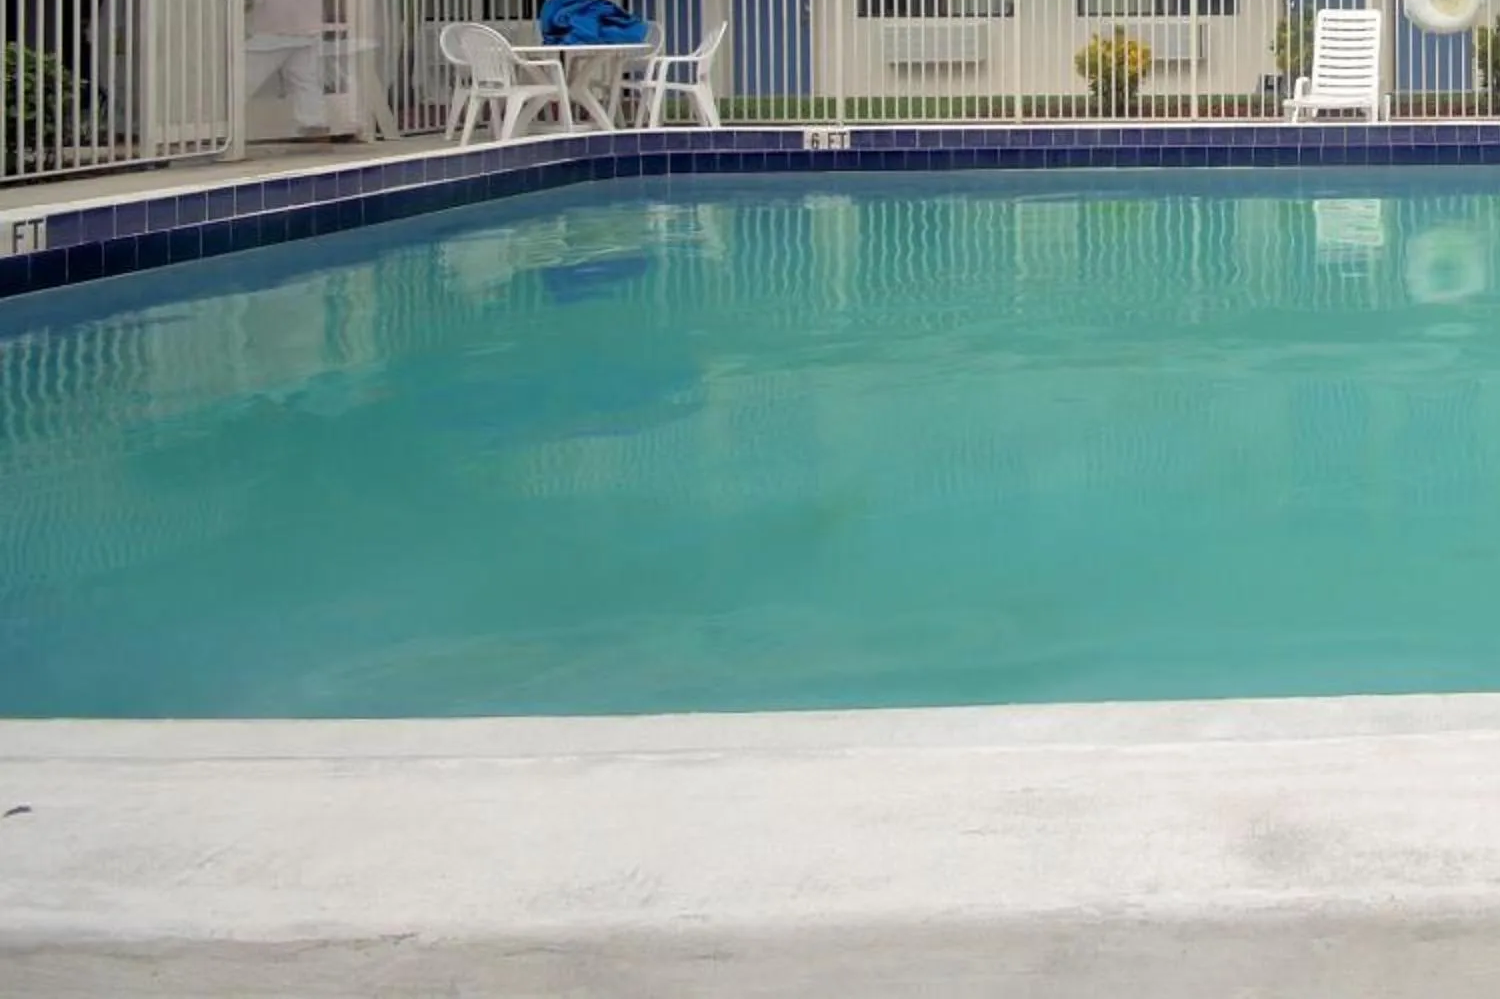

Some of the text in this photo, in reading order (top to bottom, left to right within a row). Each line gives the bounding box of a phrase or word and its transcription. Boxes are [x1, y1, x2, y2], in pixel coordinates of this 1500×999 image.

[811, 132, 847, 150] 6 FT
[12, 218, 44, 253] FT
